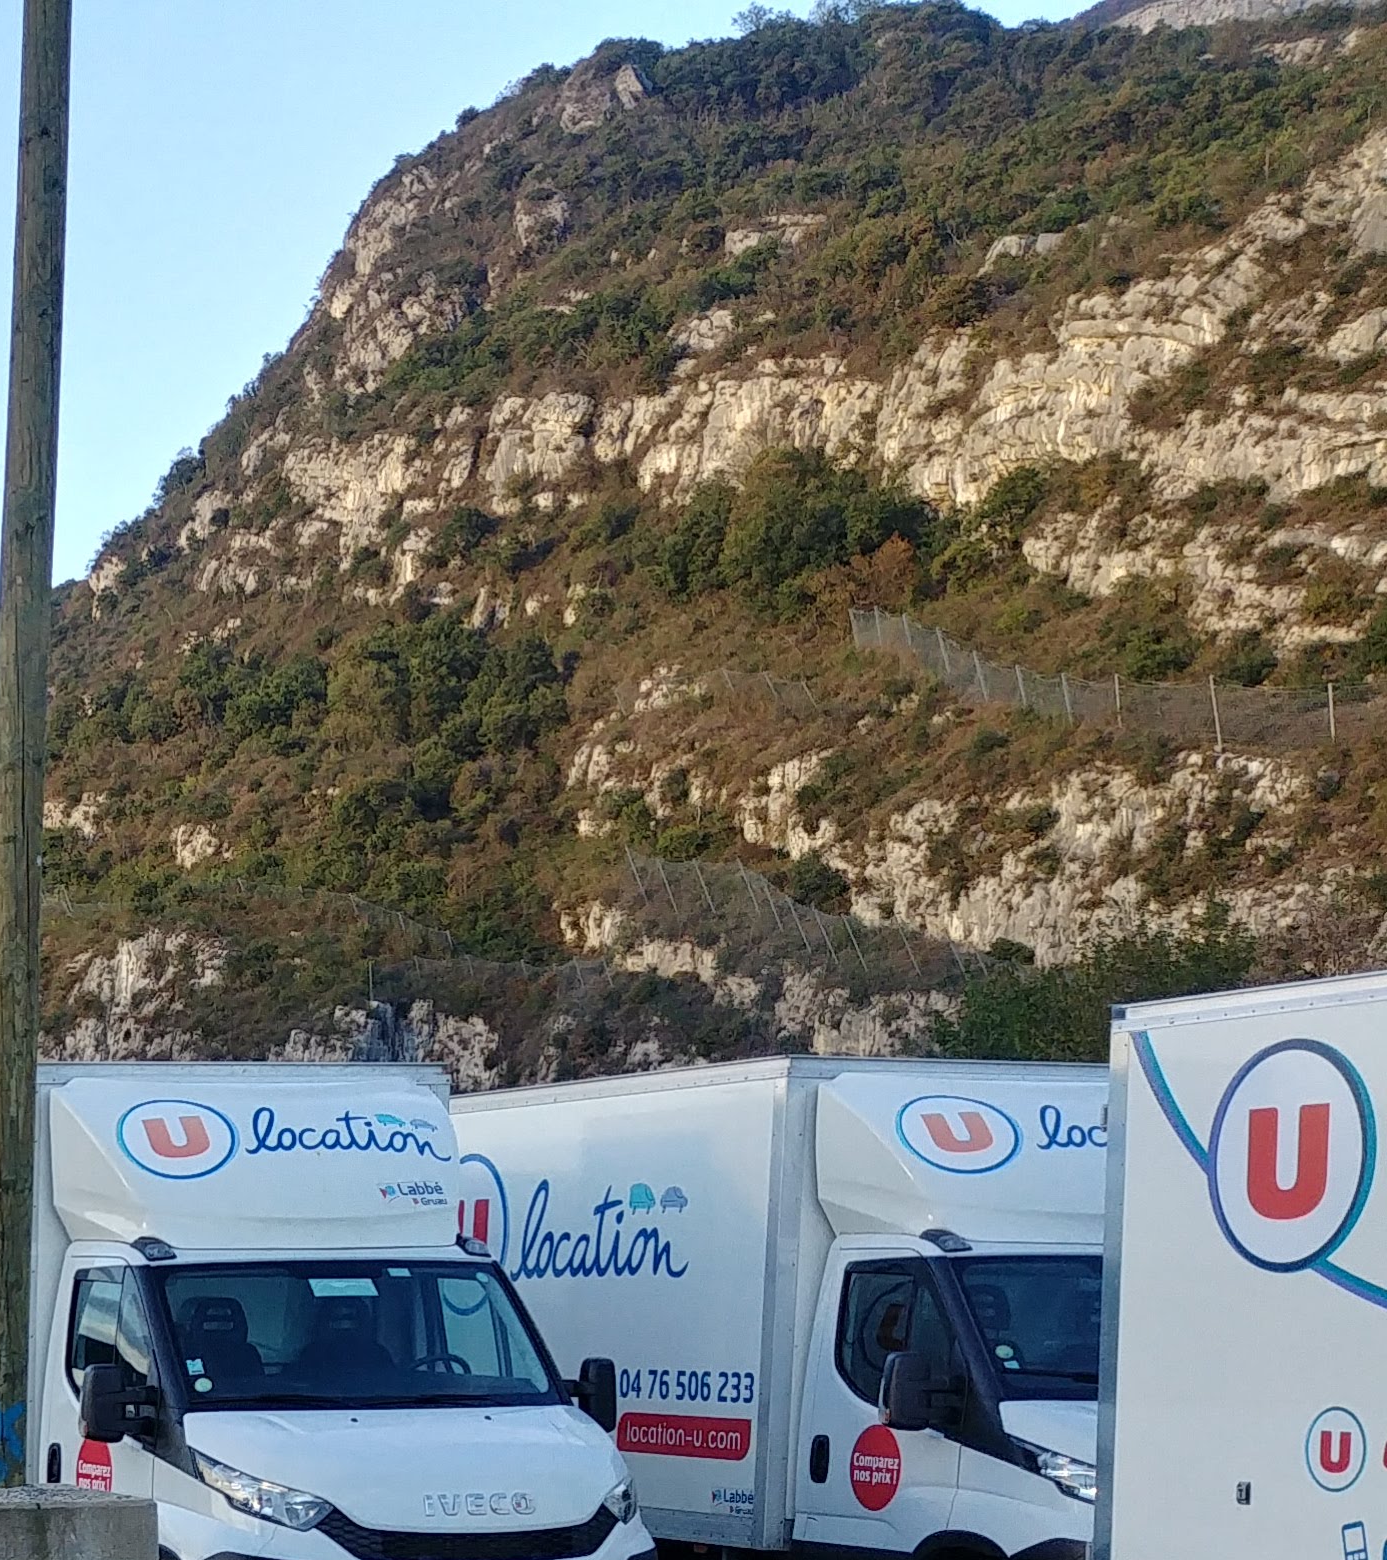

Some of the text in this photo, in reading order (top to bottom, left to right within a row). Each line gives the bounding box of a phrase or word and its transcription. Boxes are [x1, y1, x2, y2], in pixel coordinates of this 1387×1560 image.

[141, 1107, 452, 1162] U location
[920, 1111, 994, 1152] U
[1246, 1103, 1330, 1220] U
[397, 1181, 444, 1196] Labbé
[510, 1179, 689, 1281] location
[619, 1368, 755, 1403] 04 76 506 233
[627, 1420, 741, 1451] location-u.com
[1320, 1430, 1352, 1474] U
[79, 1460, 111, 1478] Comparez
[853, 1452, 900, 1470] Comparez
[854, 1470, 870, 1481] nos
[872, 1469, 891, 1486] prix
[423, 1492, 536, 1517] IVECO
